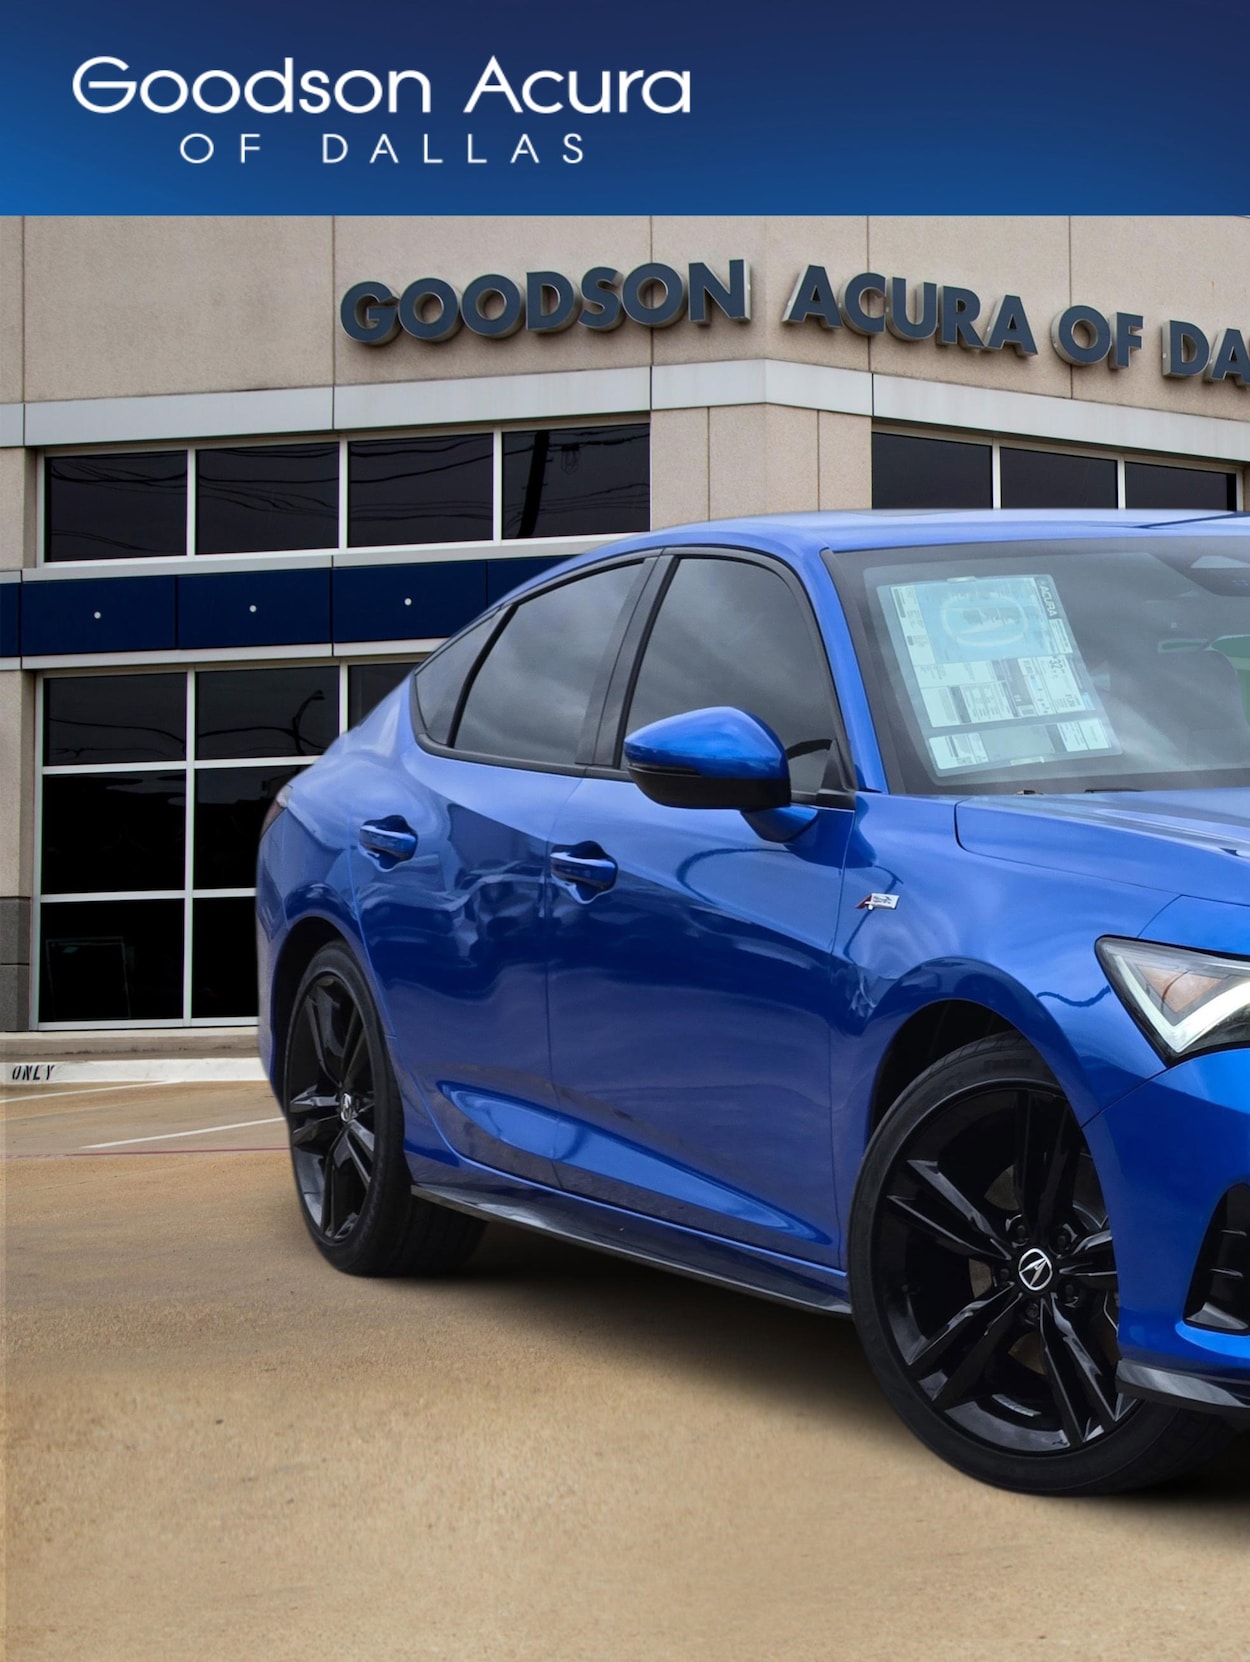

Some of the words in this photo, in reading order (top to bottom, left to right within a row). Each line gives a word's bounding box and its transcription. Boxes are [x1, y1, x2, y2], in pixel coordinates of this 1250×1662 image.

[340, 259, 751, 346] GOODSON
[782, 264, 1038, 356] ACURA
[1051, 305, 1144, 369] OF
[1040, 585, 1057, 617] ACURA
[12, 1065, 55, 1080] ONLY
